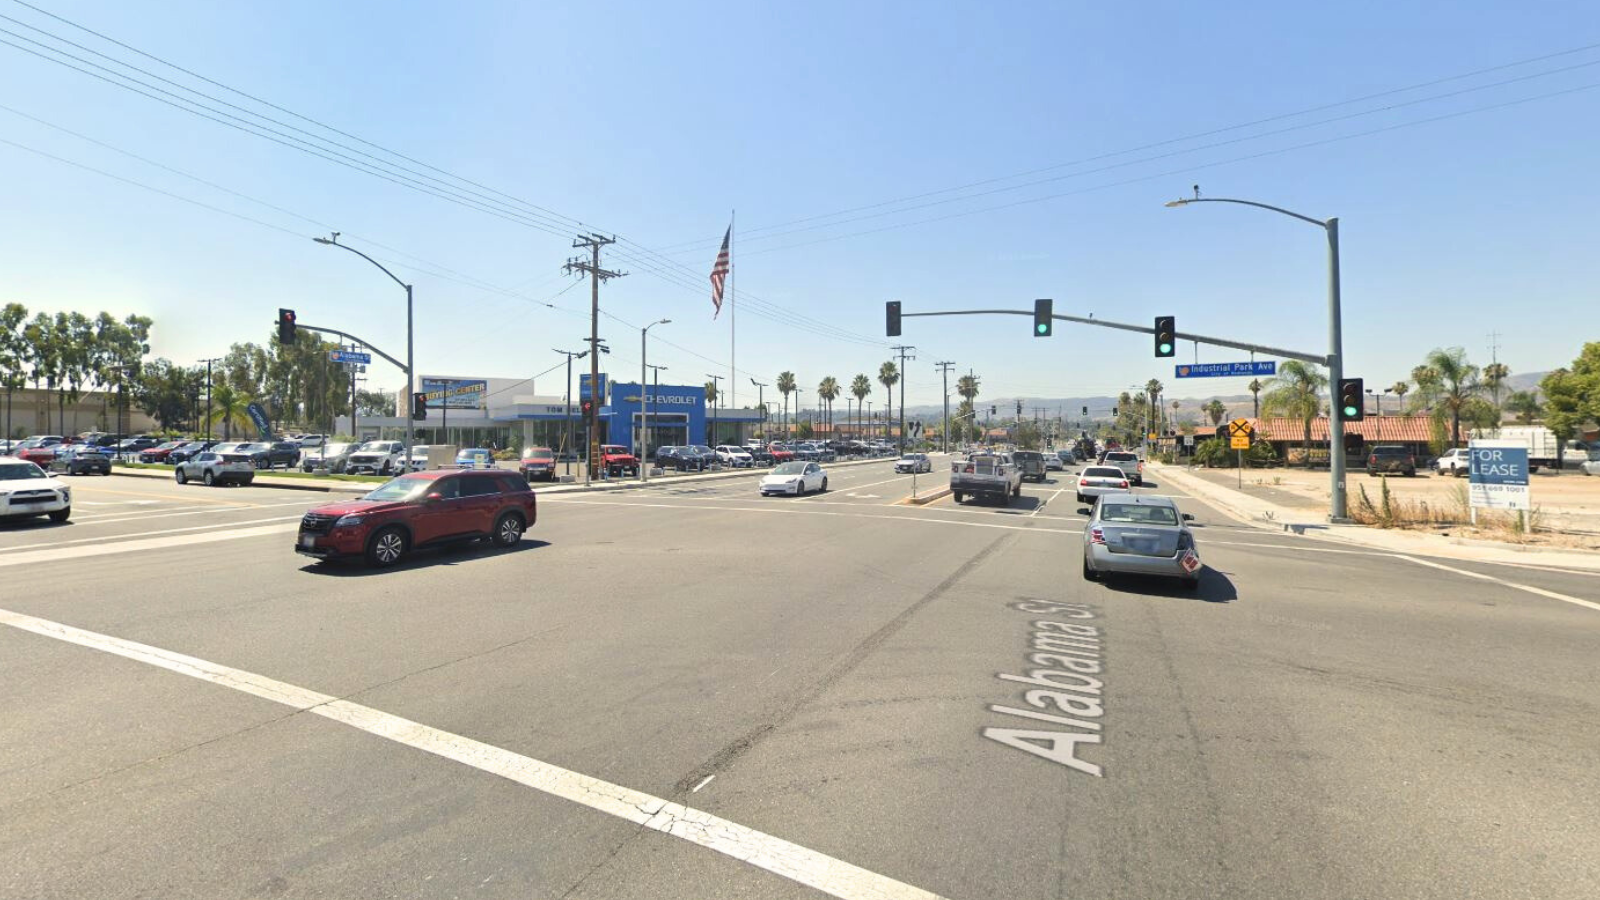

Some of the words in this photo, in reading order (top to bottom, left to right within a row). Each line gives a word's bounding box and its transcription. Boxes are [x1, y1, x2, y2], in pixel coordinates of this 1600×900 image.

[340, 352, 363, 360] Alabama
[1191, 363, 1231, 373] Industrial
[1234, 362, 1253, 371] Park
[1258, 361, 1273, 370] Ave
[456, 383, 485, 394] CENTER
[644, 394, 697, 405] CHEVROLET
[1471, 449, 1503, 462] FOR
[1471, 463, 1519, 477] LEASE
